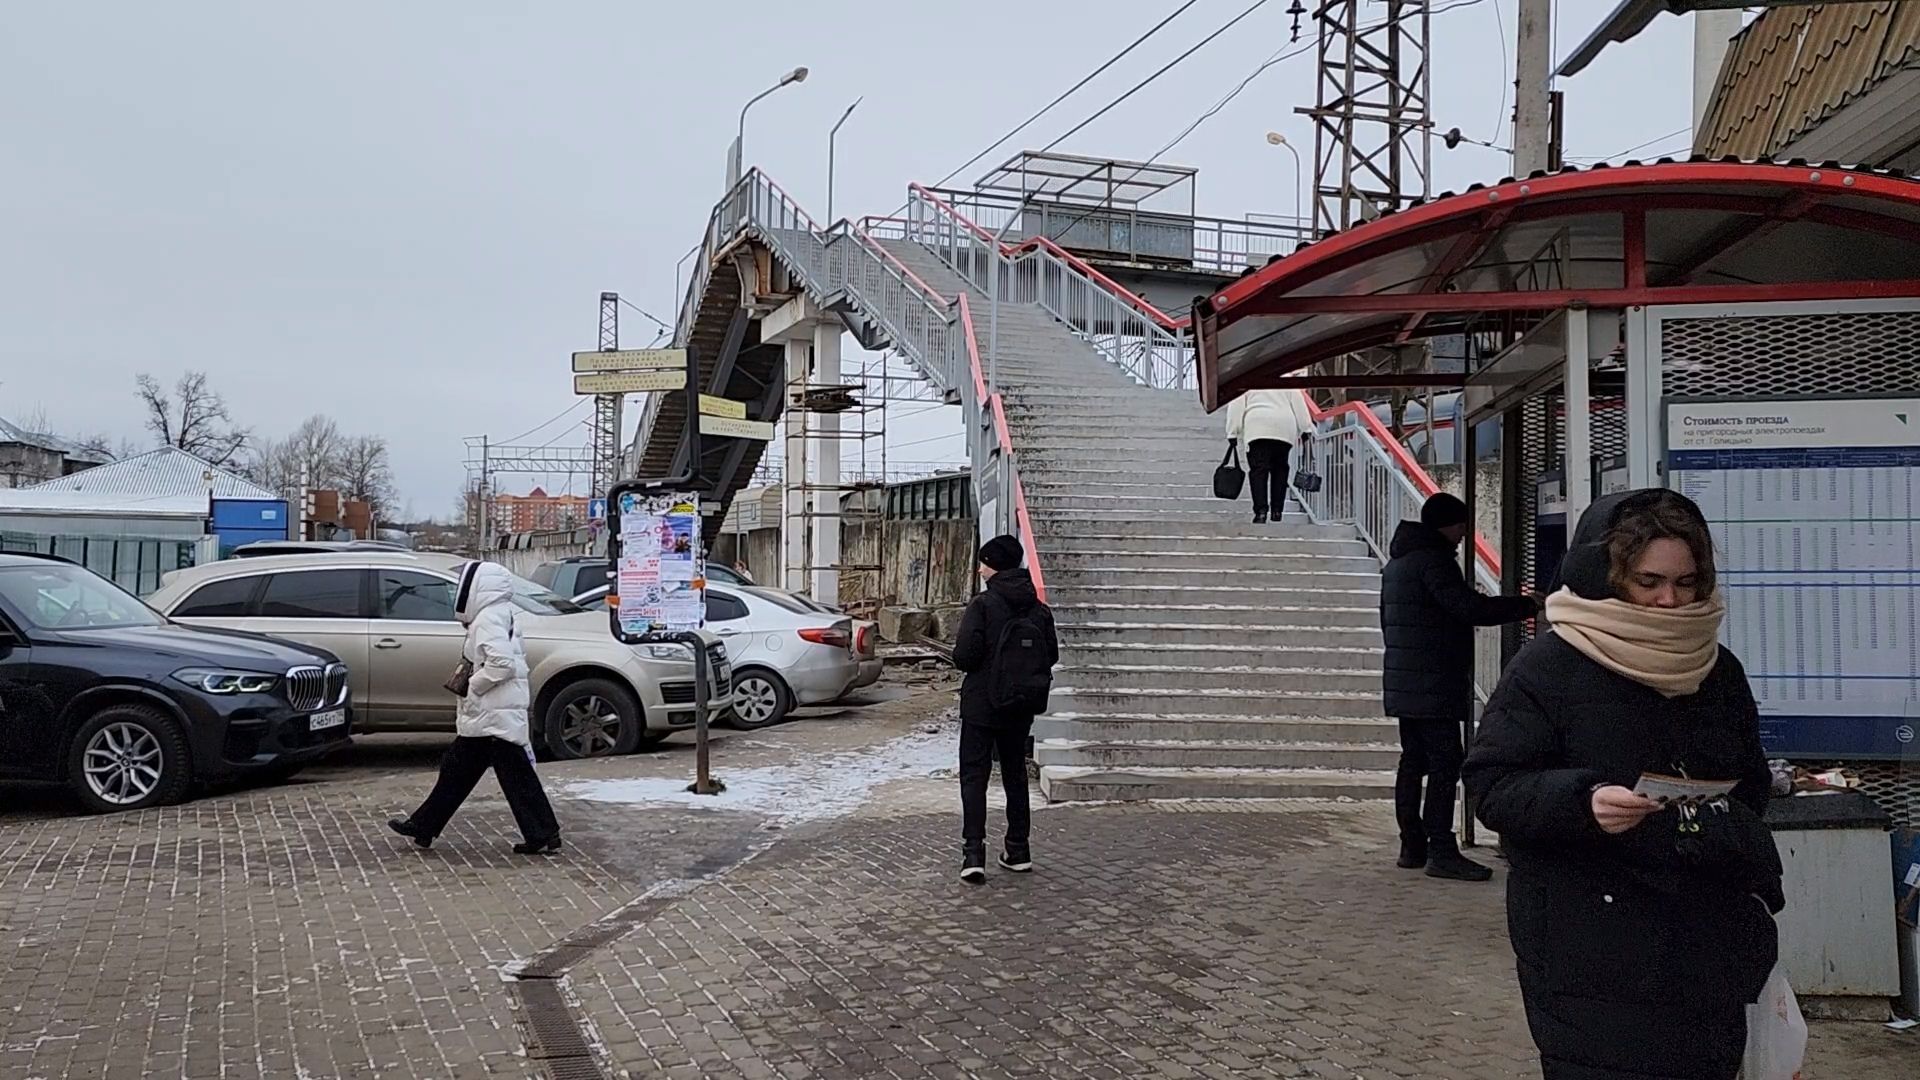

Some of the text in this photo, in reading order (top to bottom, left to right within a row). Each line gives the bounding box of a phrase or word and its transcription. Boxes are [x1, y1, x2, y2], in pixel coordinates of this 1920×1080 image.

[1696, 428, 1753, 437] пригородных
[1755, 426, 1826, 436] электропоездах
[1710, 437, 1753, 446] Голицыно
